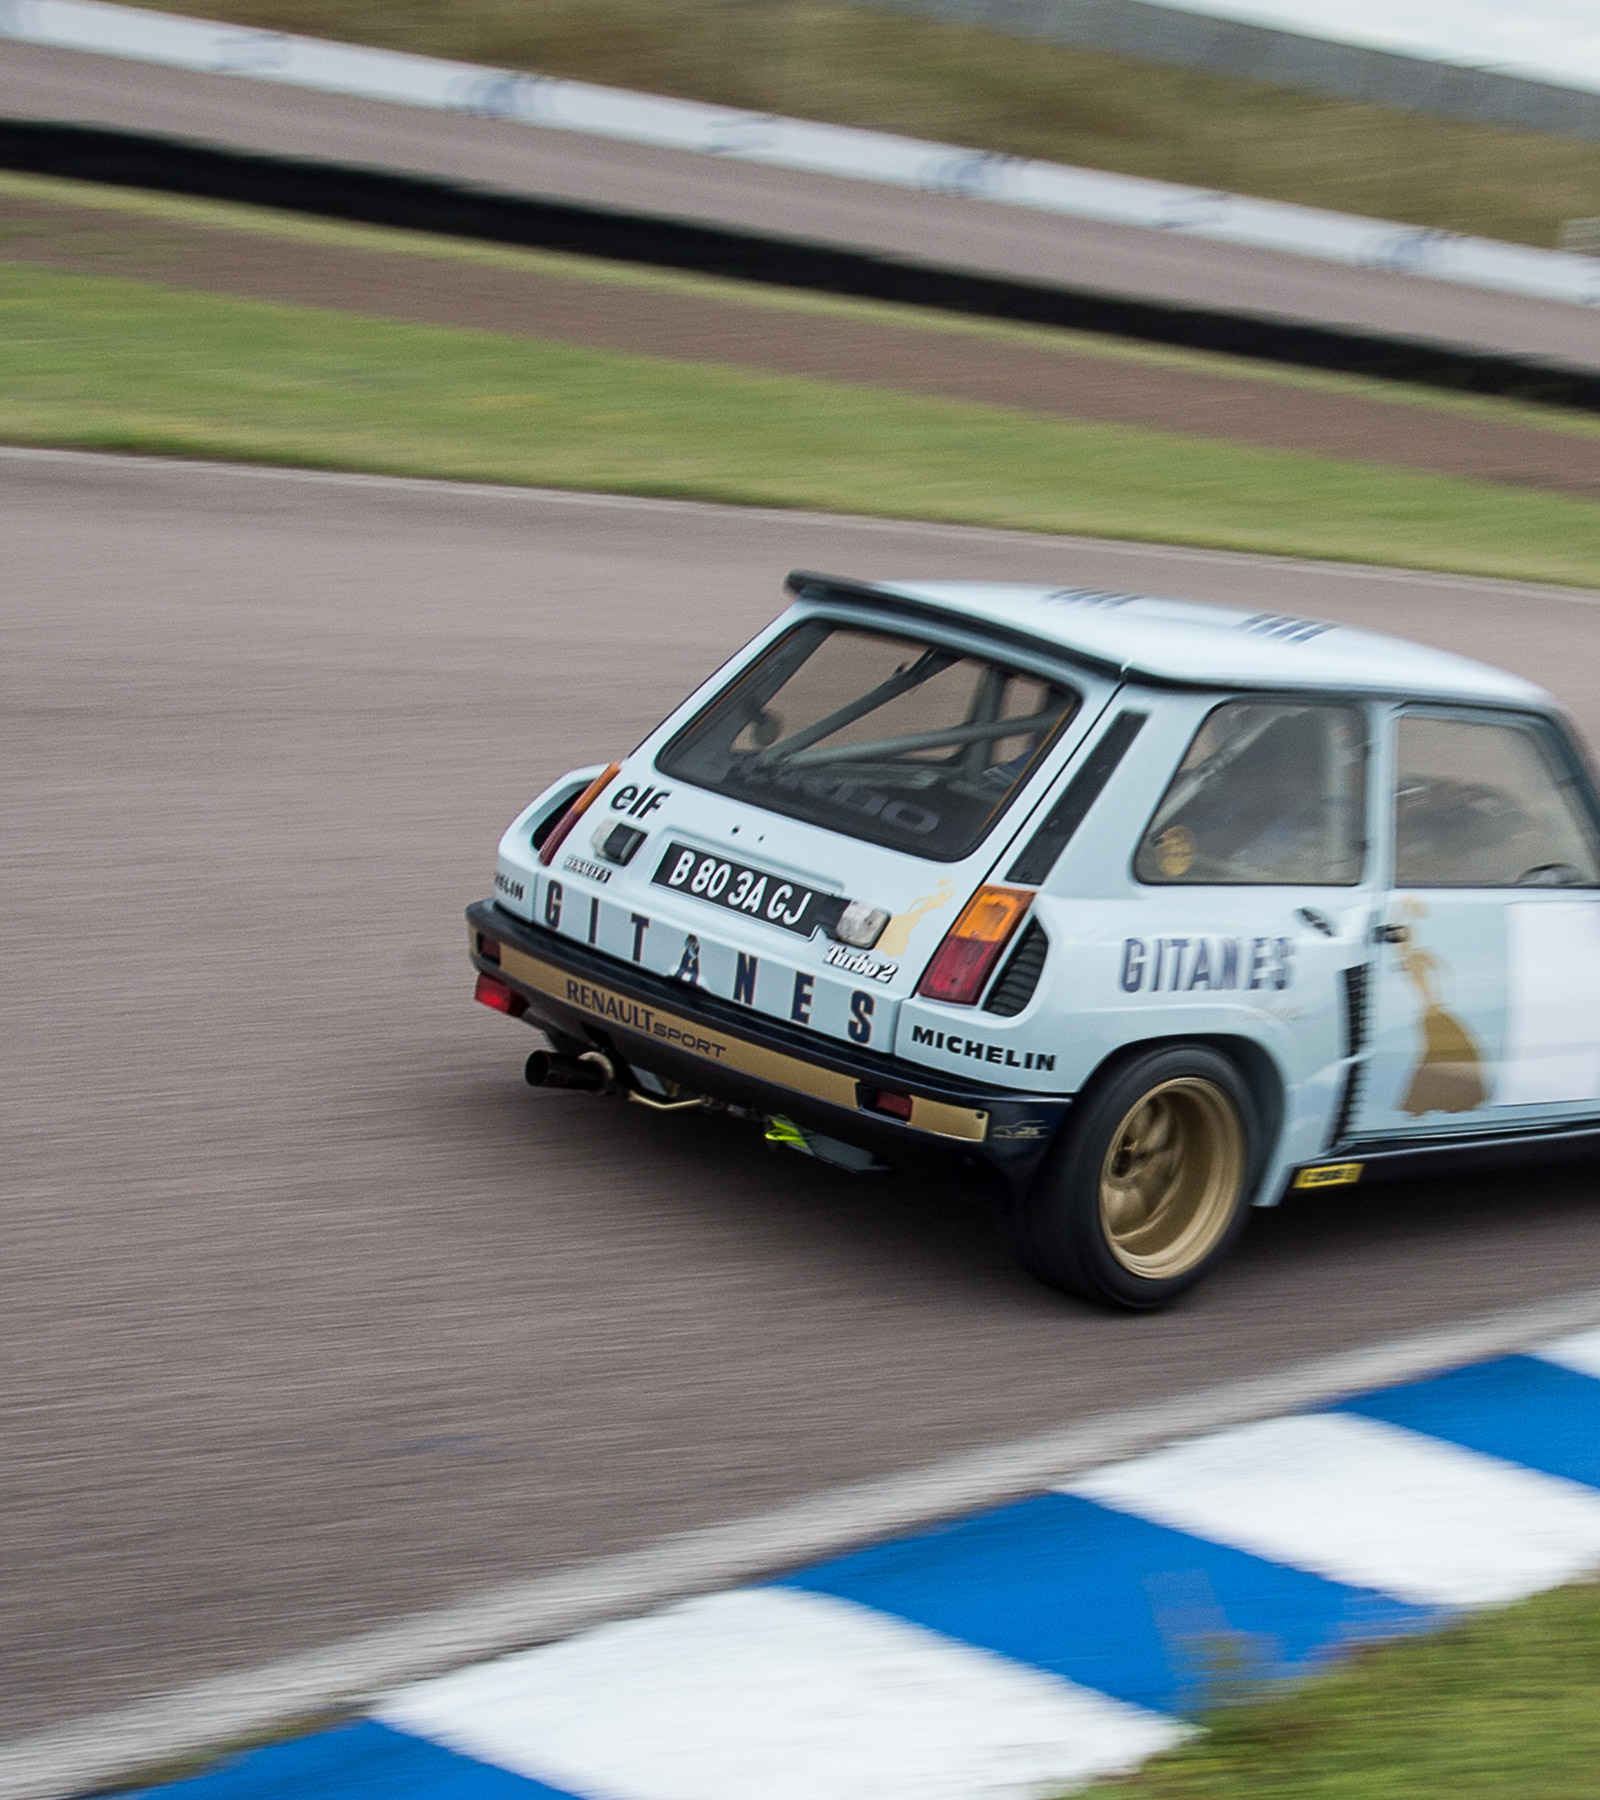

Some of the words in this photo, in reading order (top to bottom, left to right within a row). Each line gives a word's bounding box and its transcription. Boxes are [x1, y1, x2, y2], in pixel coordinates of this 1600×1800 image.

[545, 879, 875, 1044] GITANES
[1120, 937, 1294, 993] GITANES
[911, 1025, 1057, 1072] MICHELIN
